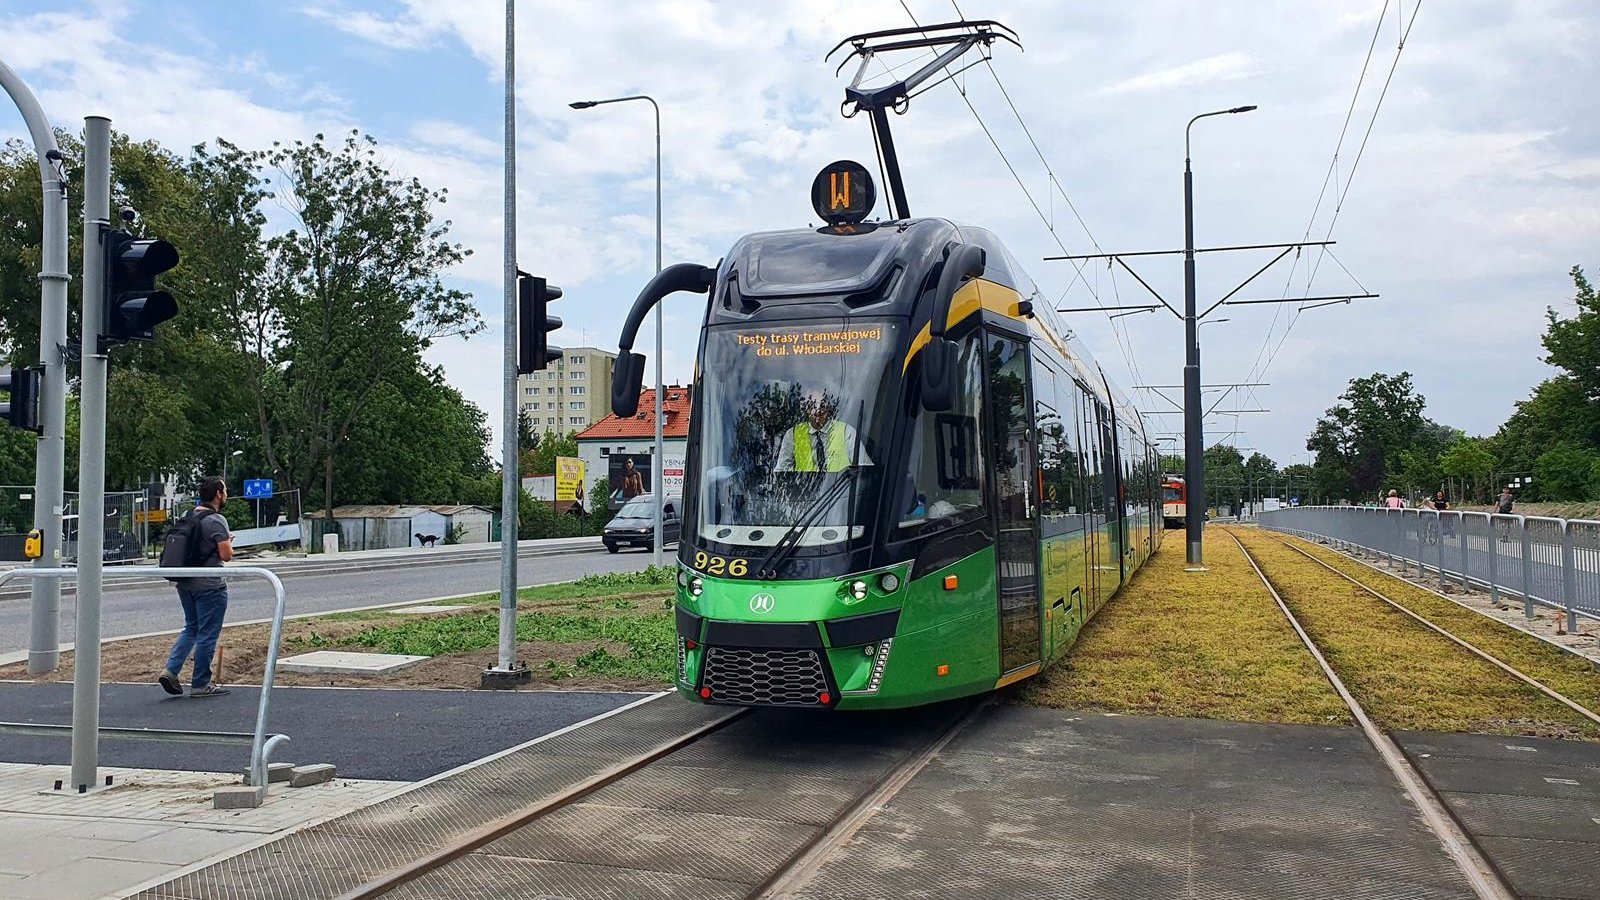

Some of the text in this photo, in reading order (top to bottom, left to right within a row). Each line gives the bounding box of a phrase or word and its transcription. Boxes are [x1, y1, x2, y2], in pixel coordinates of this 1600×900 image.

[830, 171, 850, 210] W
[737, 328, 880, 345] Testy trasy tramwajowej
[756, 342, 861, 357] do ul. Włodarskiej
[694, 551, 748, 577] 926
